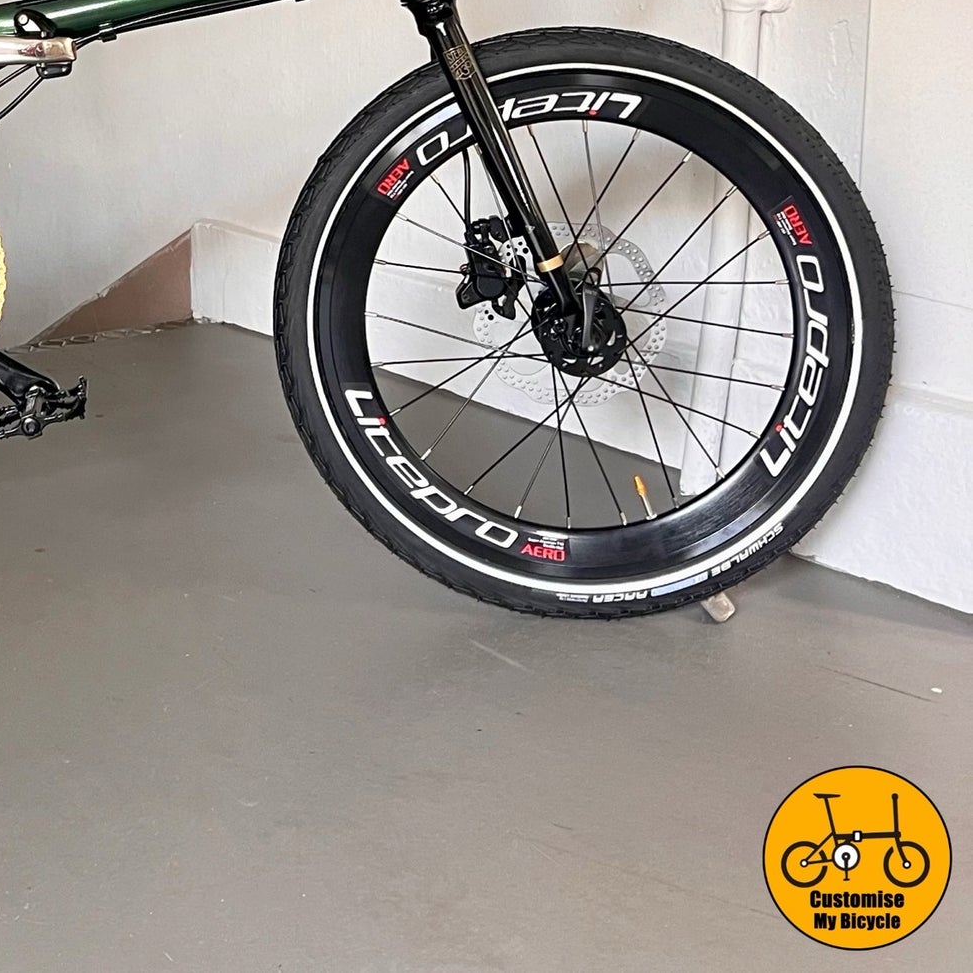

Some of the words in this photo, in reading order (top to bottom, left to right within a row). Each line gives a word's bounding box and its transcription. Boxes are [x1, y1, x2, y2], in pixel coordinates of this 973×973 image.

[377, 158, 410, 195] AERO
[784, 205, 813, 244] AERO
[759, 253, 830, 479] Litepro
[345, 388, 519, 549] Litepro
[521, 543, 565, 562] AERO
[711, 521, 785, 576] SCHWALBE
[592, 589, 649, 604] RACER
